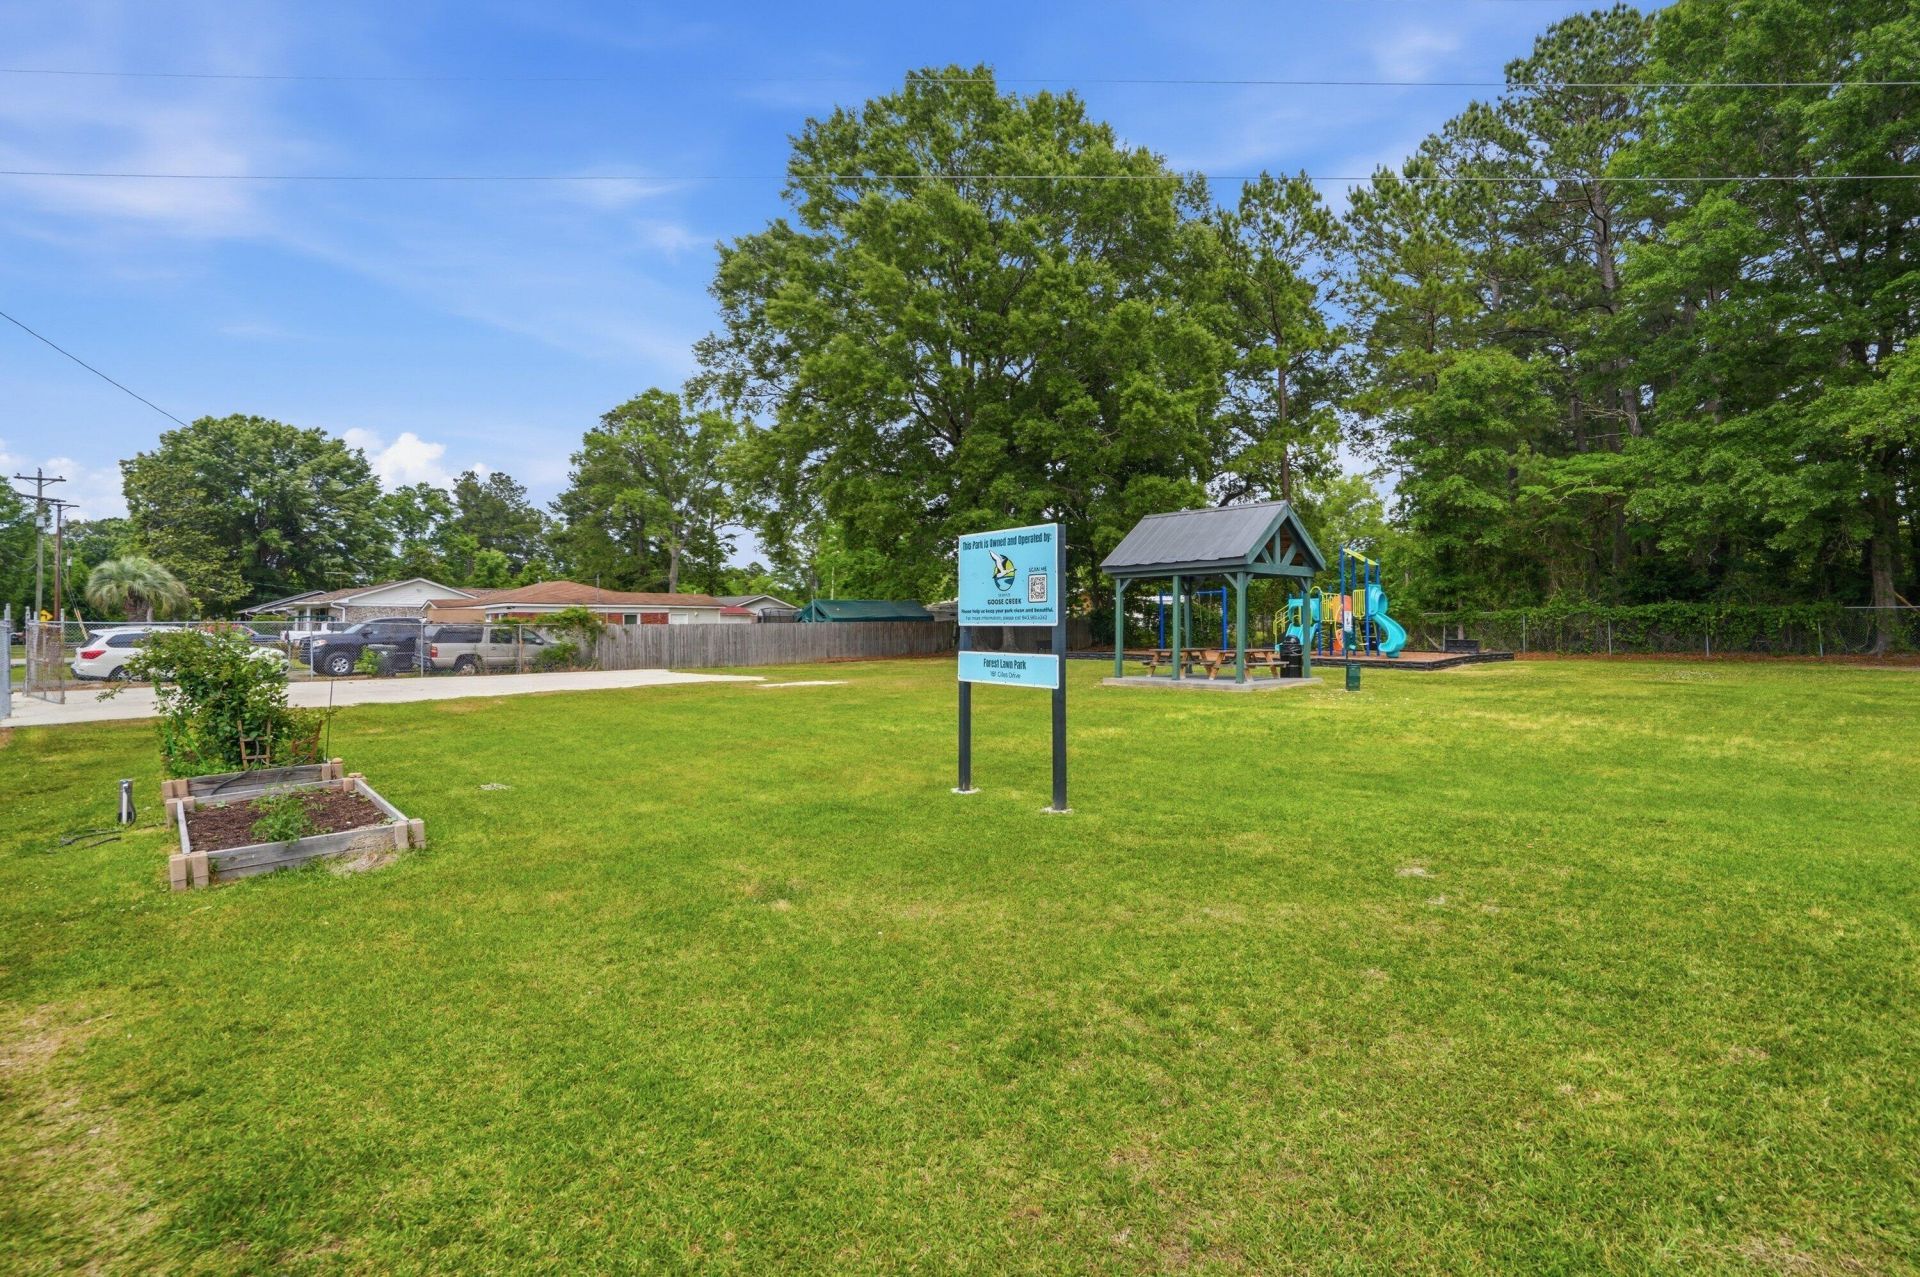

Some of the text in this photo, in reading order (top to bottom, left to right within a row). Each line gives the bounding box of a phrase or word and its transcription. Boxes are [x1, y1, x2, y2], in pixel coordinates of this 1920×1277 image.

[962, 541, 971, 551] This
[972, 540, 983, 550] Park
[984, 539, 989, 549] is
[990, 538, 1006, 548] Owned
[1007, 536, 1017, 546] and
[1018, 533, 1042, 546] Operated
[983, 658, 1026, 670] Forest Lawn Park
